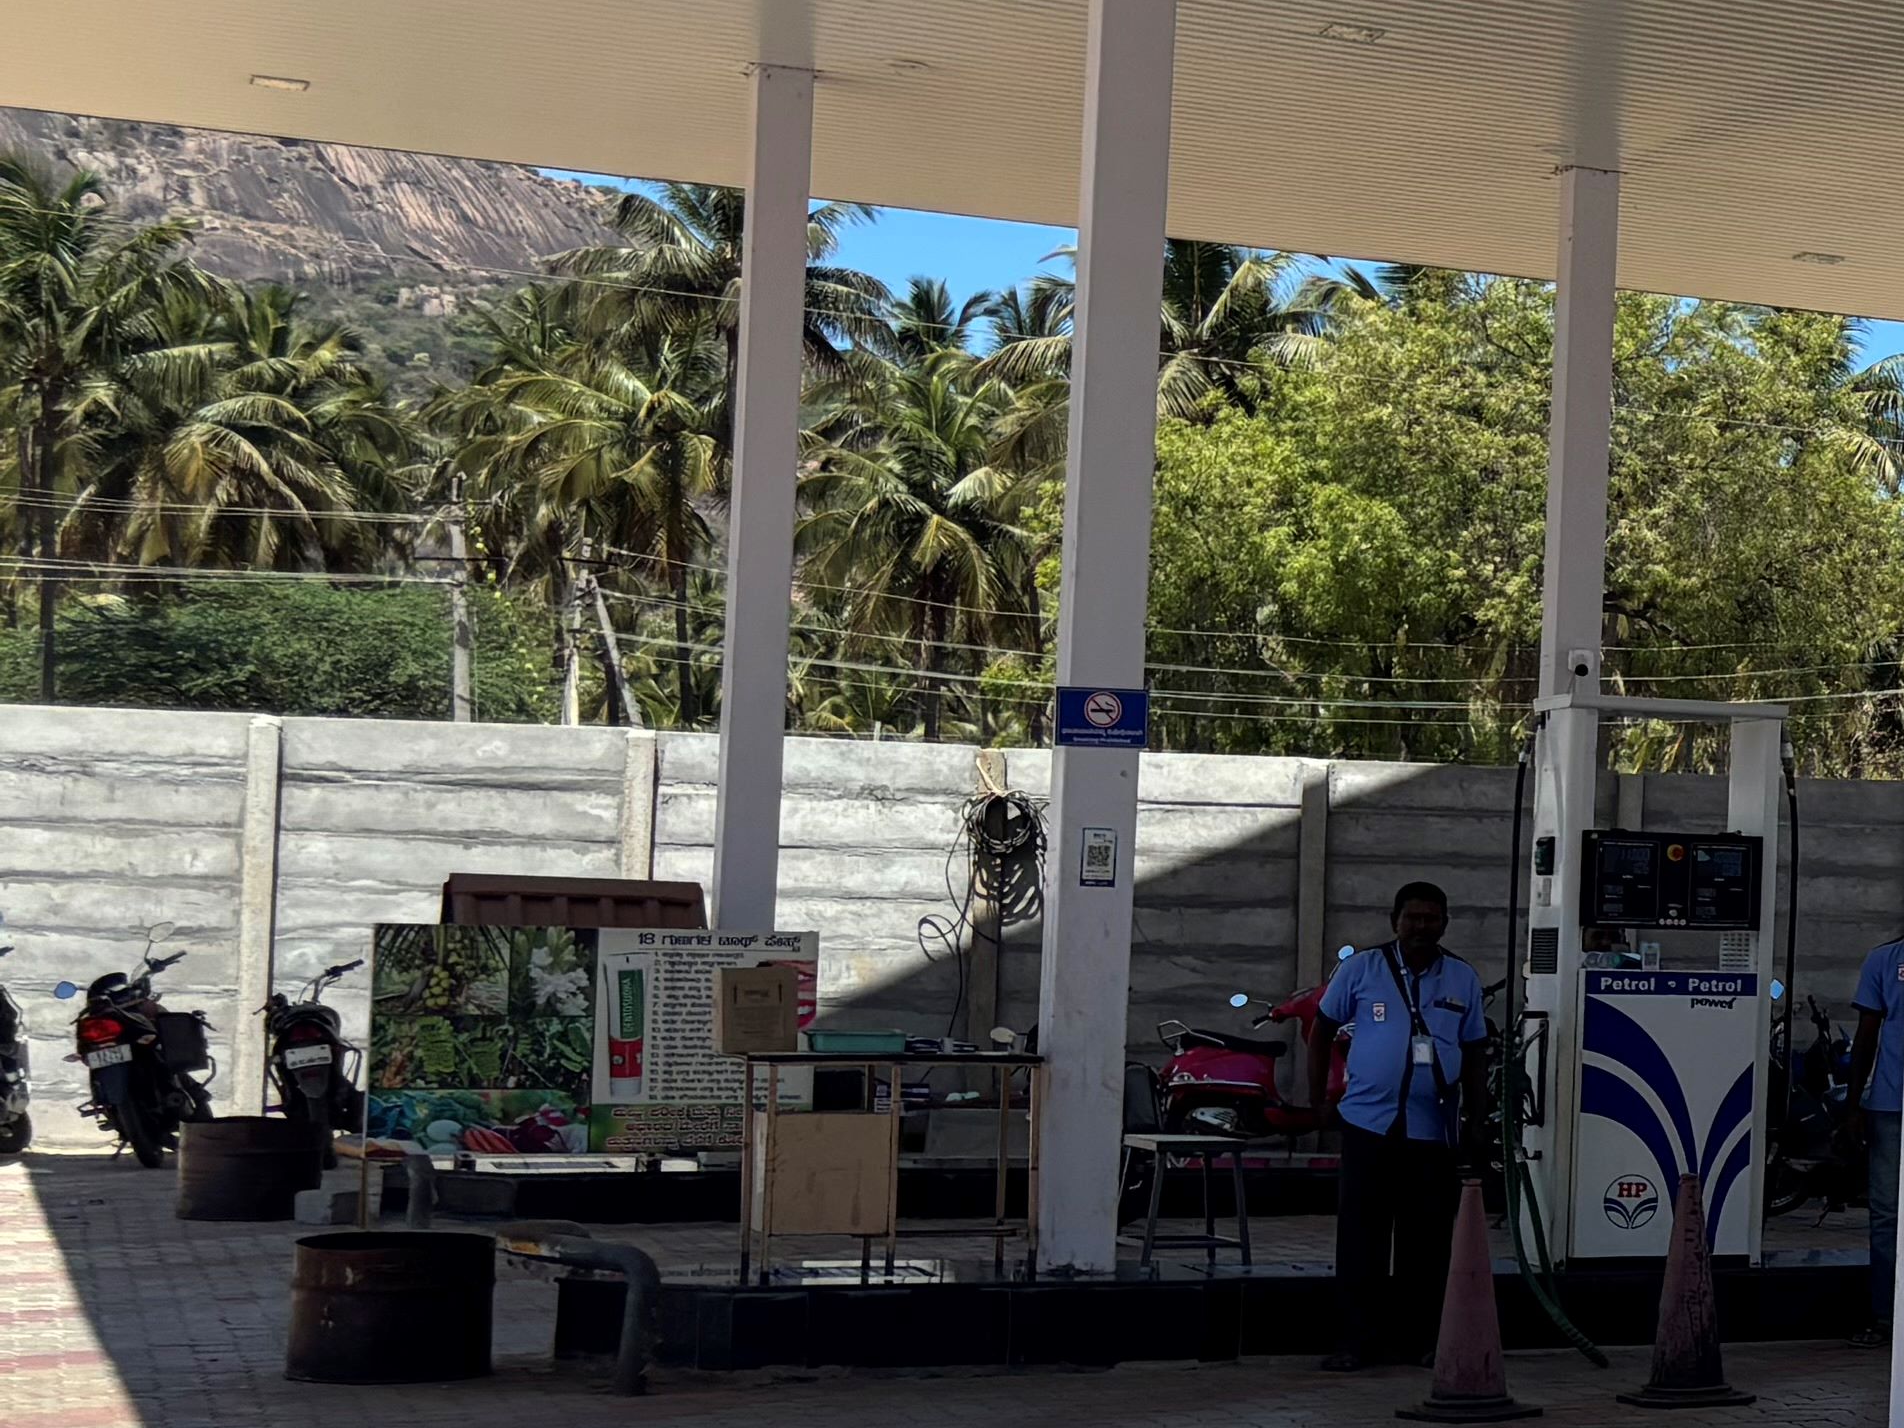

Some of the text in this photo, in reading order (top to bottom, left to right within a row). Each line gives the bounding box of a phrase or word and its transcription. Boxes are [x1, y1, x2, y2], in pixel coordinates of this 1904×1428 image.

[638, 932, 655, 945] 18
[1600, 975, 1742, 992] Petrol Petrol
[1690, 997, 1736, 1010] power
[1617, 1182, 1647, 1199] HP
